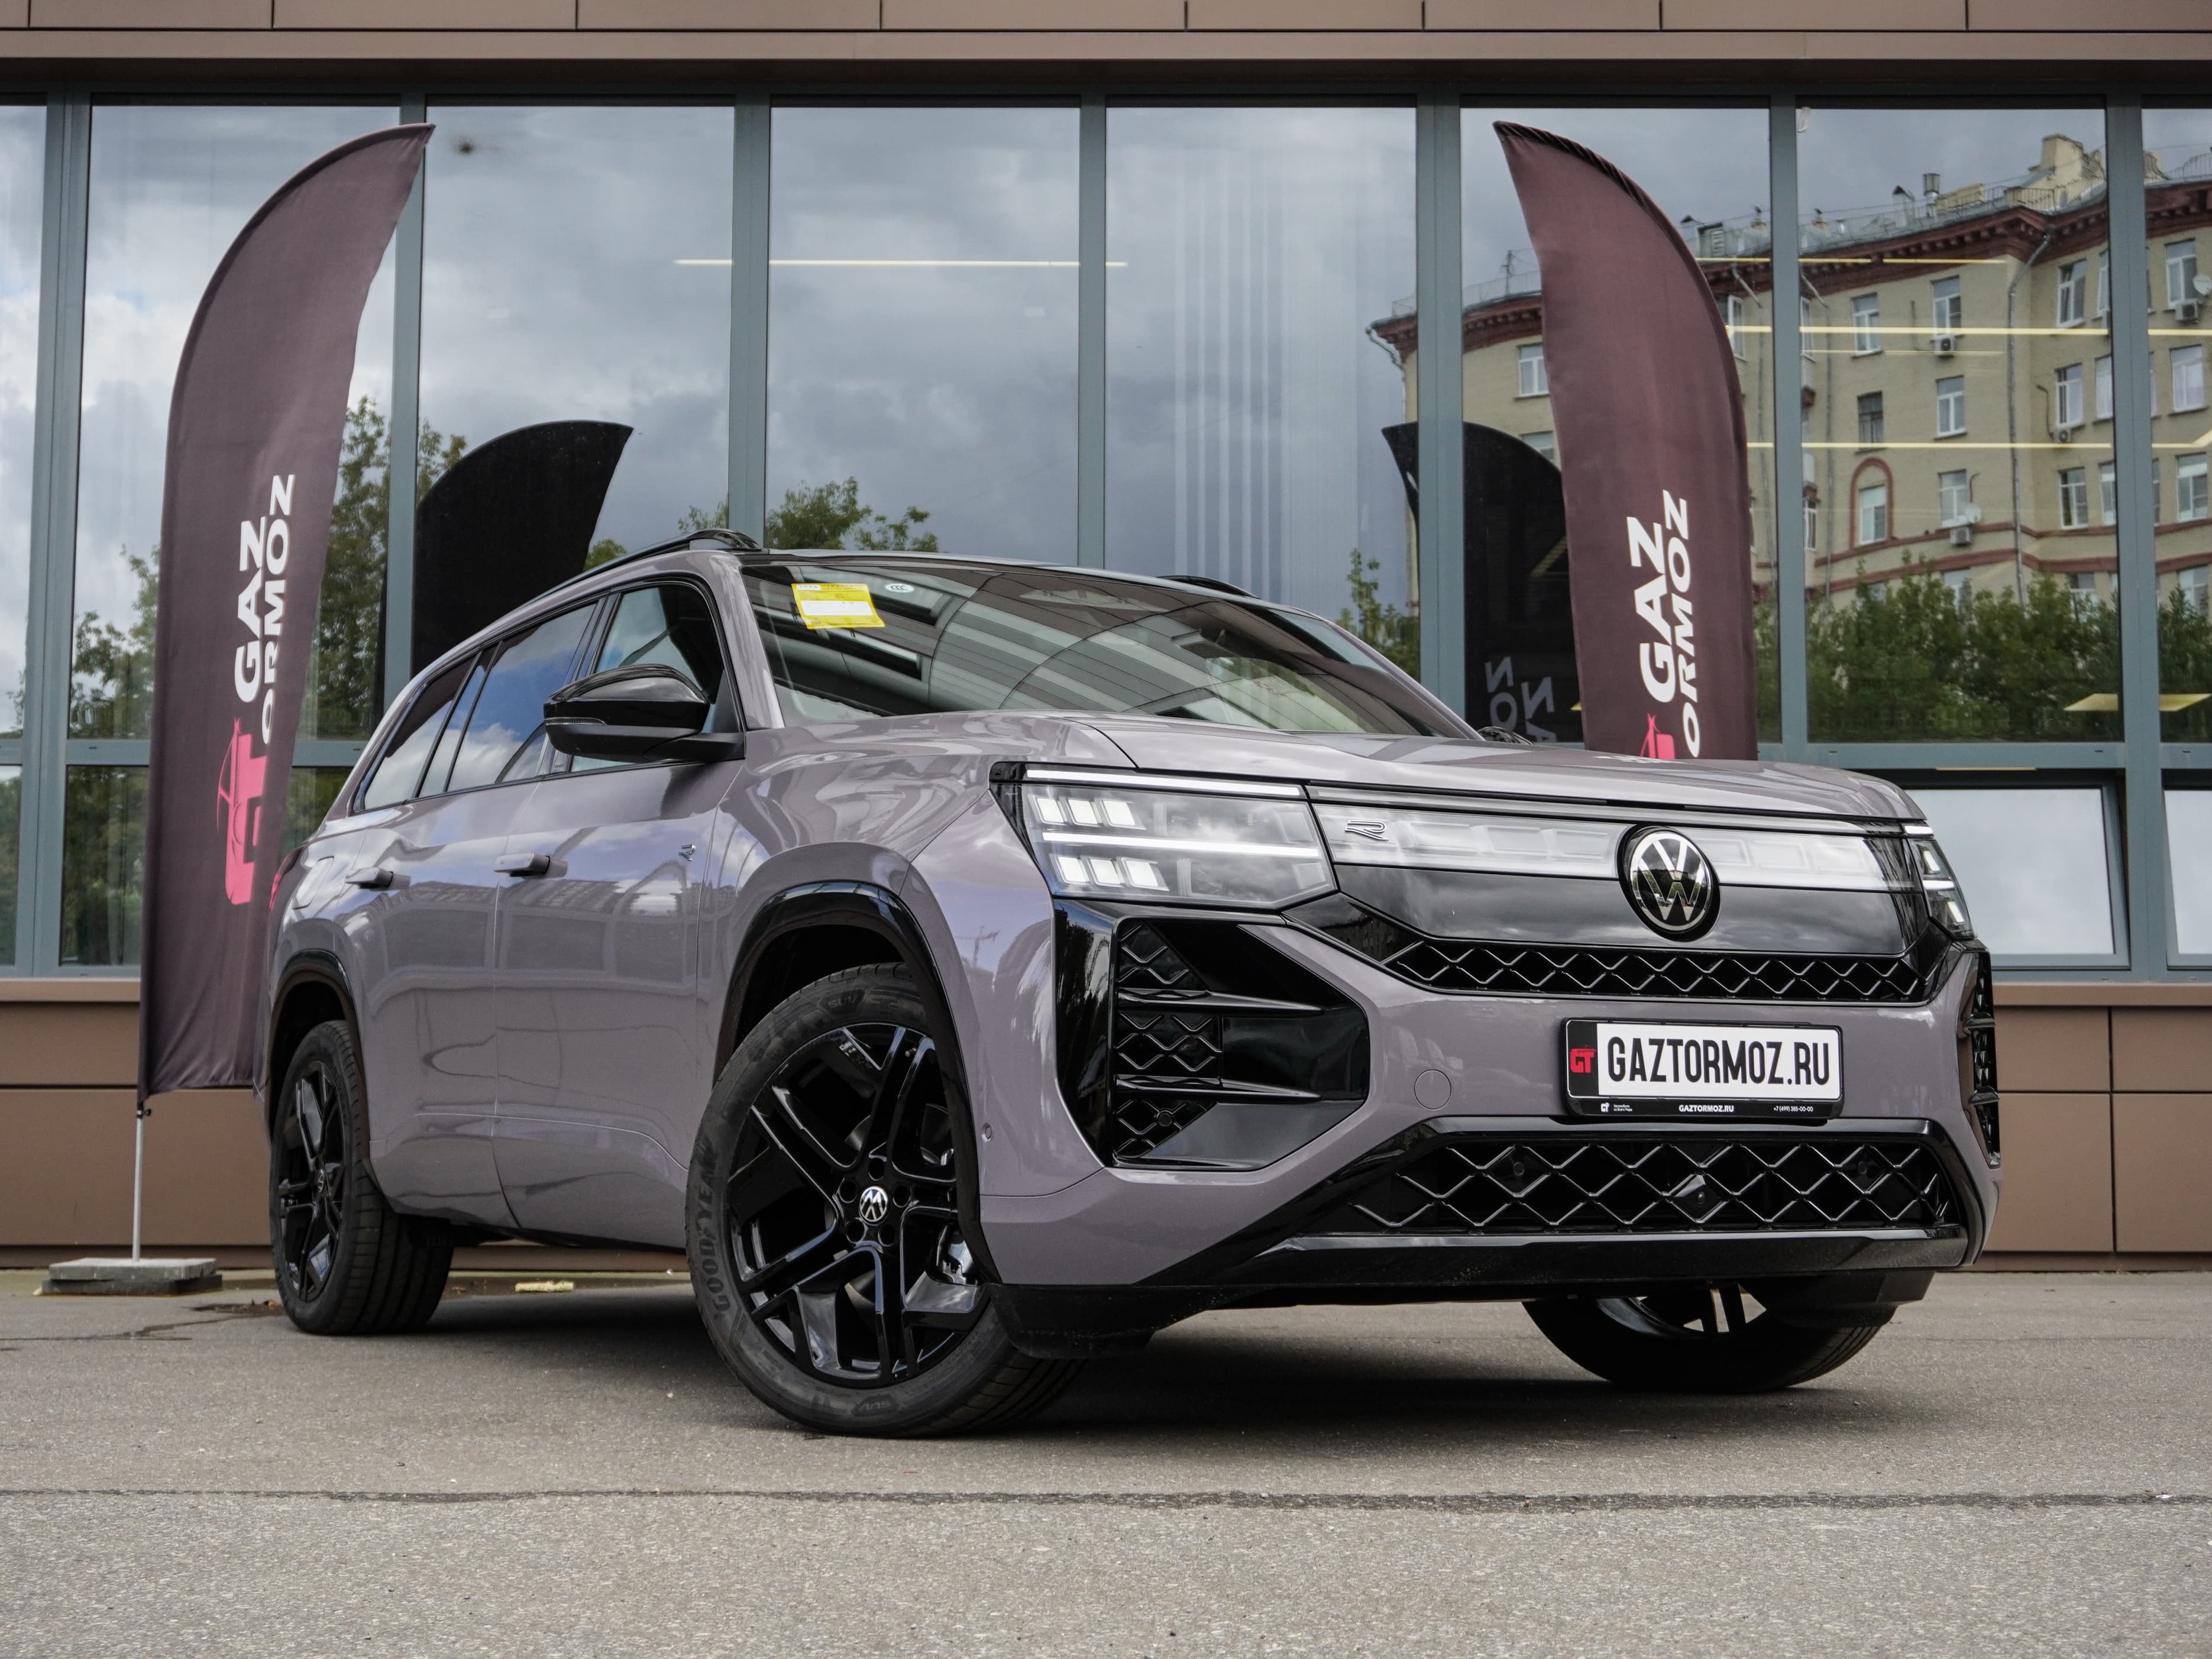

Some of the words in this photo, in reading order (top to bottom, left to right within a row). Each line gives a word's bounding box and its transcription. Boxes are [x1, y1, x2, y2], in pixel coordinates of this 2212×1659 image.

[235, 516, 266, 703] GAZ
[1626, 516, 1676, 703] GAZ
[1344, 820, 1389, 842] R
[1607, 1036, 1831, 1086] GAZTORMOZ.RU
[1679, 1104, 1735, 1113] GAZTORMOZ.RU
